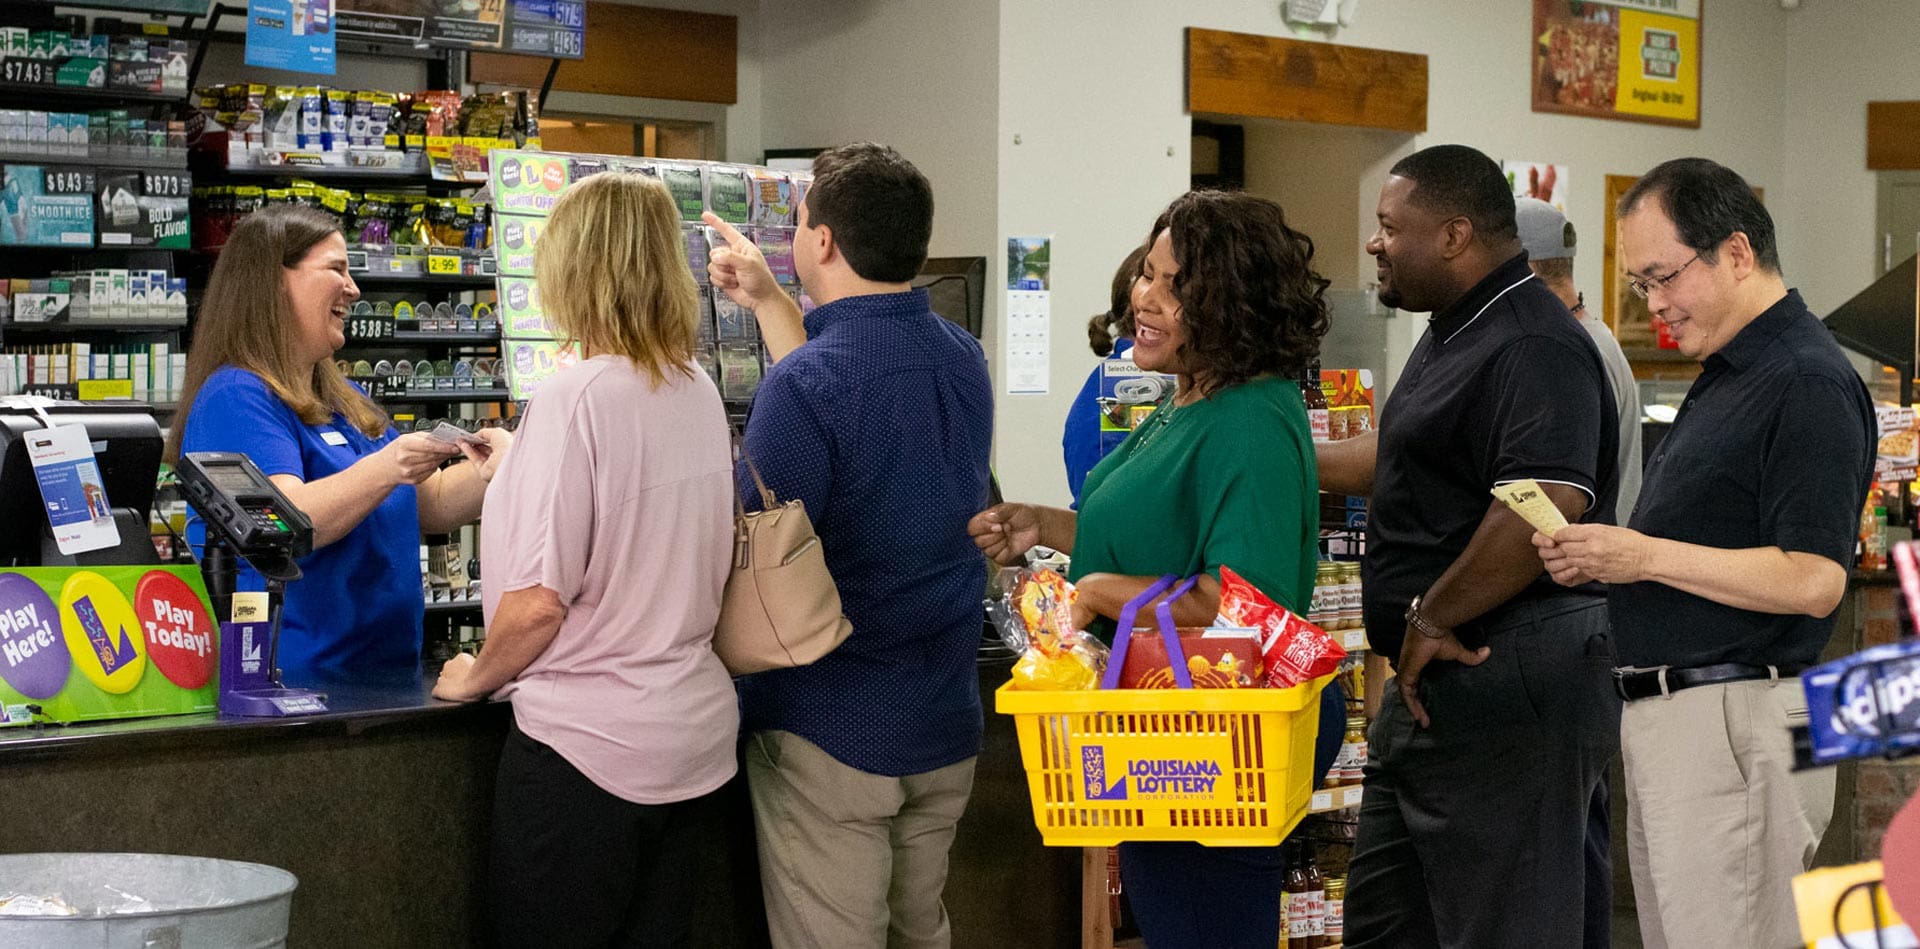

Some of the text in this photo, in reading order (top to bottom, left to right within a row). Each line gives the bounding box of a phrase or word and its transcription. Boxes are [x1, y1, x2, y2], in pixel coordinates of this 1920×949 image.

[31, 205, 91, 219] SMOOTH ICE
[149, 207, 173, 223] BOLD
[154, 221, 188, 238] FLAVOR
[351, 319, 382, 338] $5.88
[0, 603, 39, 639] Play
[153, 599, 195, 632] Play
[2, 620, 55, 667] Here!
[145, 622, 212, 657] Today!
[1283, 643, 1316, 671] NIGHT
[1128, 760, 1222, 776] LOUISIANA
[1137, 777, 1216, 793] LOTTERY
